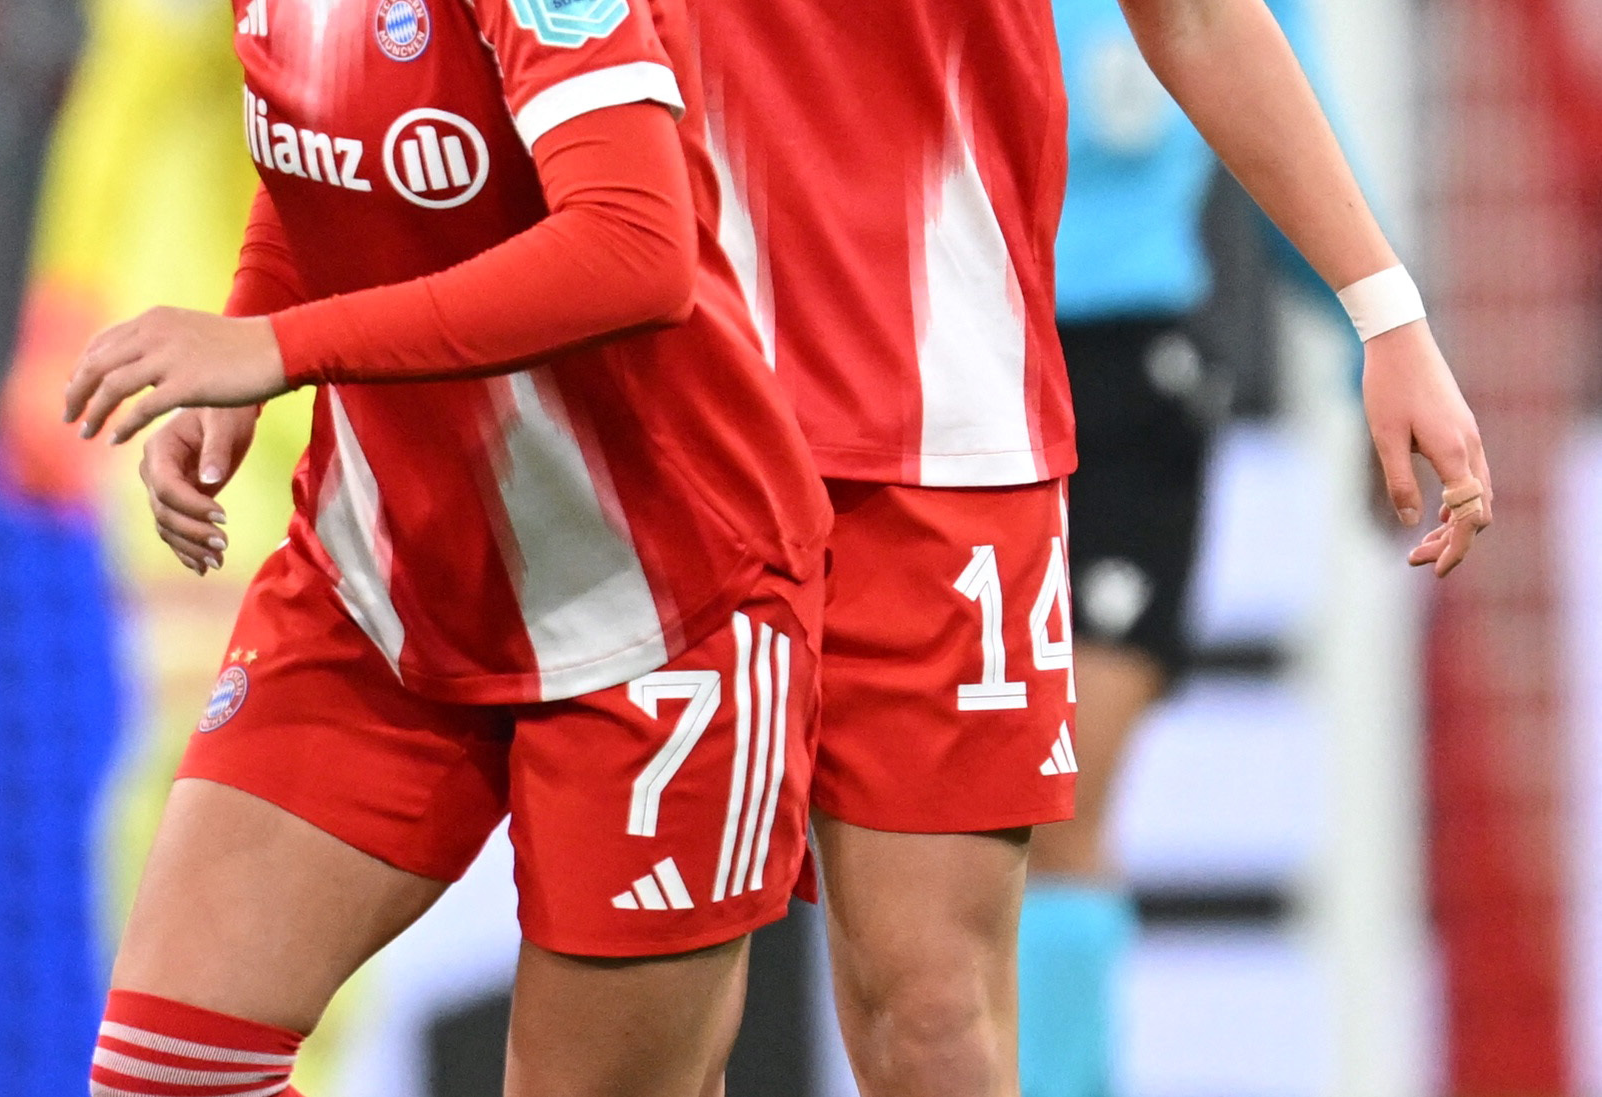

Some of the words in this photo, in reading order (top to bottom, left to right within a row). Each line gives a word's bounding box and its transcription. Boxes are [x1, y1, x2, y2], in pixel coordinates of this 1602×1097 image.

[380, 2, 391, 17] FC
[244, 82, 373, 192] llianz
[953, 537, 1077, 711] 14
[627, 669, 722, 838] 7
